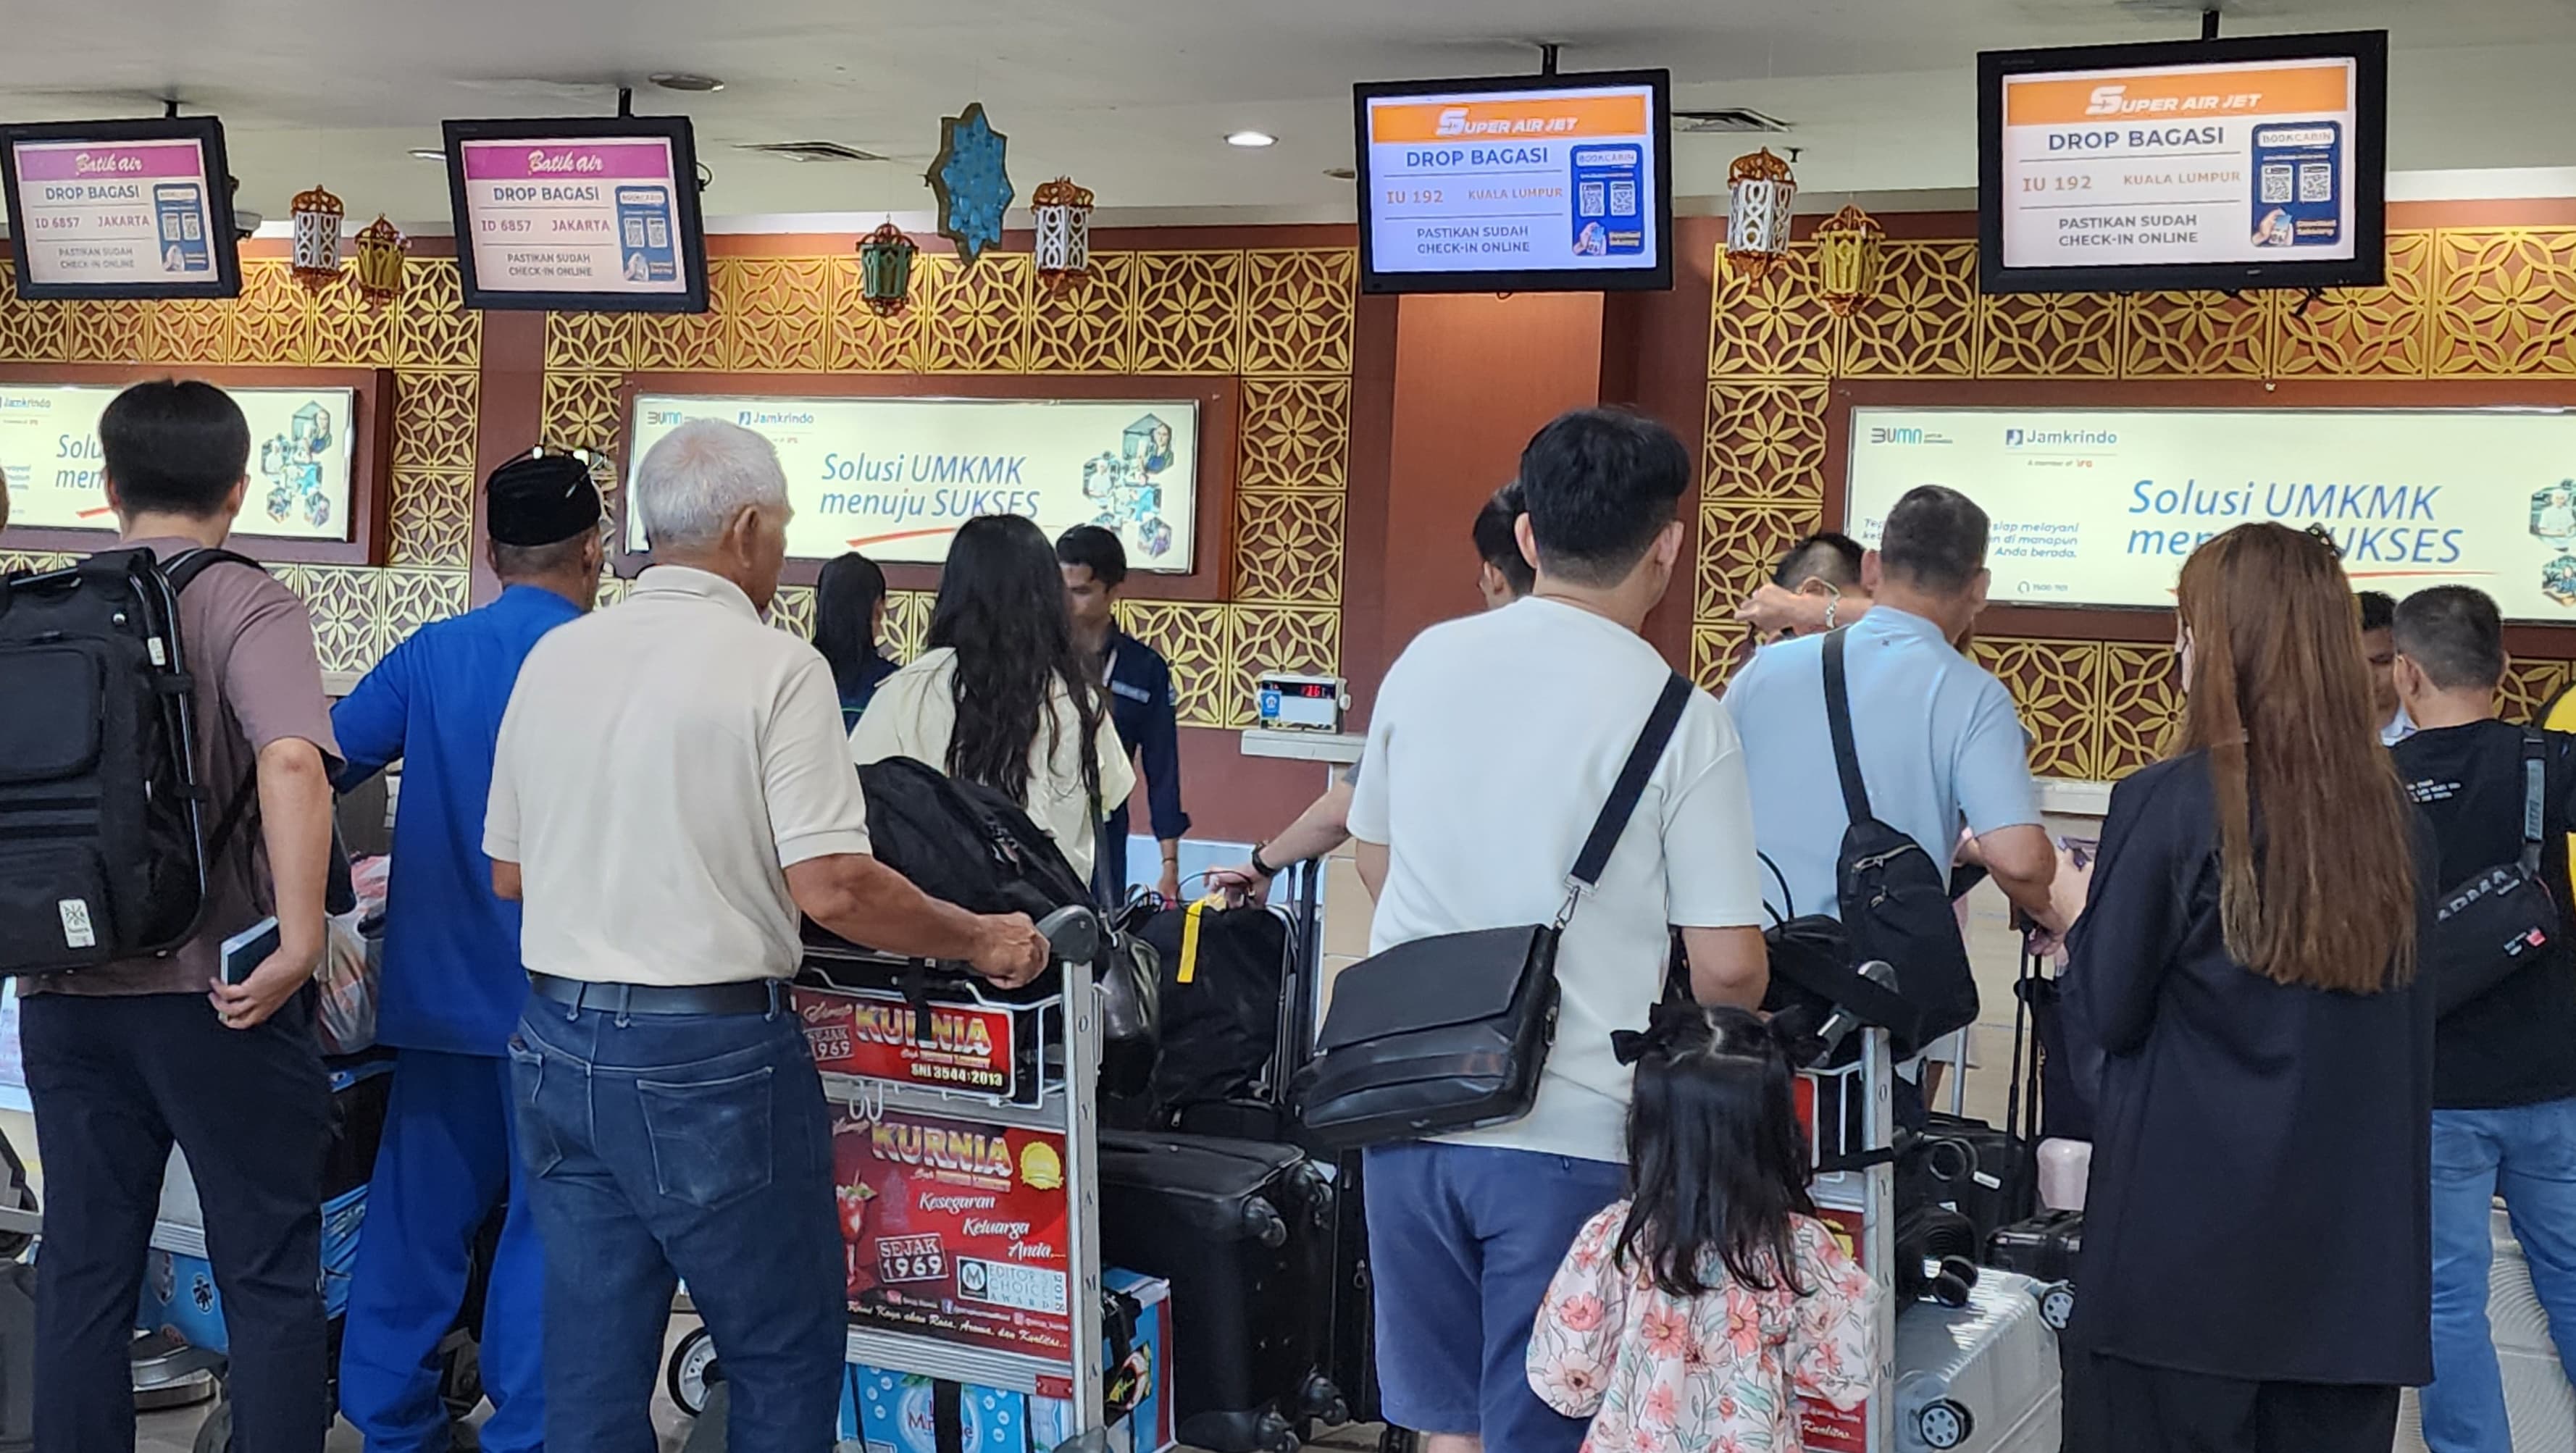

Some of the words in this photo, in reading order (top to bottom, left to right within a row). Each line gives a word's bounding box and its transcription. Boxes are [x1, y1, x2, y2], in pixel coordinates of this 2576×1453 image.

[2086, 85, 2177, 115] SUPER
[2181, 96, 2220, 110] AIR
[2222, 93, 2263, 108] JET
[1512, 119, 1543, 133] AIR
[1545, 117, 1578, 132] JET
[2049, 133, 2120, 151] DROP
[2128, 127, 2225, 148] BAGASI
[75, 152, 117, 175] Batik
[117, 157, 143, 172] air
[527, 150, 575, 175] Batik
[577, 154, 604, 172] air
[1406, 151, 1465, 167] DROP
[1471, 148, 1549, 165] BAGASI
[2023, 177, 2046, 192] IU
[2054, 176, 2092, 190] 192
[2123, 175, 2173, 186] KUALA
[2179, 172, 2241, 184] LUMPUR
[45, 187, 83, 201] DROP
[88, 185, 141, 199] BAGASI
[493, 188, 537, 201] DROP
[541, 187, 600, 201] BAGASI
[1387, 191, 1406, 204] IU
[1413, 190, 1444, 204] 192
[1468, 189, 1508, 200] KUALA
[1512, 187, 1563, 199] LUMPUR
[35, 218, 49, 229] ID
[52, 217, 80, 229] 6857
[97, 215, 150, 227] JAKARTA
[481, 220, 497, 232] ID
[501, 219, 531, 232] 6857
[552, 219, 611, 233] JAKARTA
[2059, 217, 2136, 230] PASTIKAN
[2141, 214, 2198, 227] SUDAH
[1417, 227, 1479, 239] PASTIKAN
[1483, 226, 1529, 238] SUDAH
[2059, 233, 2134, 247] CHECK-IN
[2138, 231, 2199, 245] ONLINE
[1417, 242, 1479, 254] CHECK-IN
[1481, 242, 1530, 253] ONLINE
[507, 253, 554, 264] PASTIKAN
[556, 254, 591, 264] SUDAH
[509, 266, 555, 276] CHECK-IN
[557, 267, 593, 277] ONLINE
[753, 411, 815, 424] Jamkrindo
[2027, 430, 2118, 445] Jamkrindo
[56, 434, 102, 459] Solu
[821, 452, 905, 483] Solusi
[911, 456, 1026, 485] UMKMK
[819, 488, 926, 523] menuju
[932, 489, 1041, 519] SUKSES
[2128, 478, 2254, 516] Solusi
[2266, 483, 2443, 521] UMKMK
[2021, 522, 2080, 535] melayani
[2004, 535, 2016, 544] di
[2018, 537, 2078, 547] manapun
[2327, 527, 2463, 564] UKSES
[1994, 547, 2028, 557] Anda
[2031, 547, 2077, 558] berada.
[855, 1003, 992, 1056] KUNIA
[871, 1121, 1013, 1177] KURNIA
[919, 1192, 996, 1213] Kesegaran
[962, 1218, 1030, 1239] Keluarga
[879, 1237, 940, 1258] SEJAK
[883, 1255, 943, 1278] 1969
[989, 1278, 1048, 1298] CHOICE
